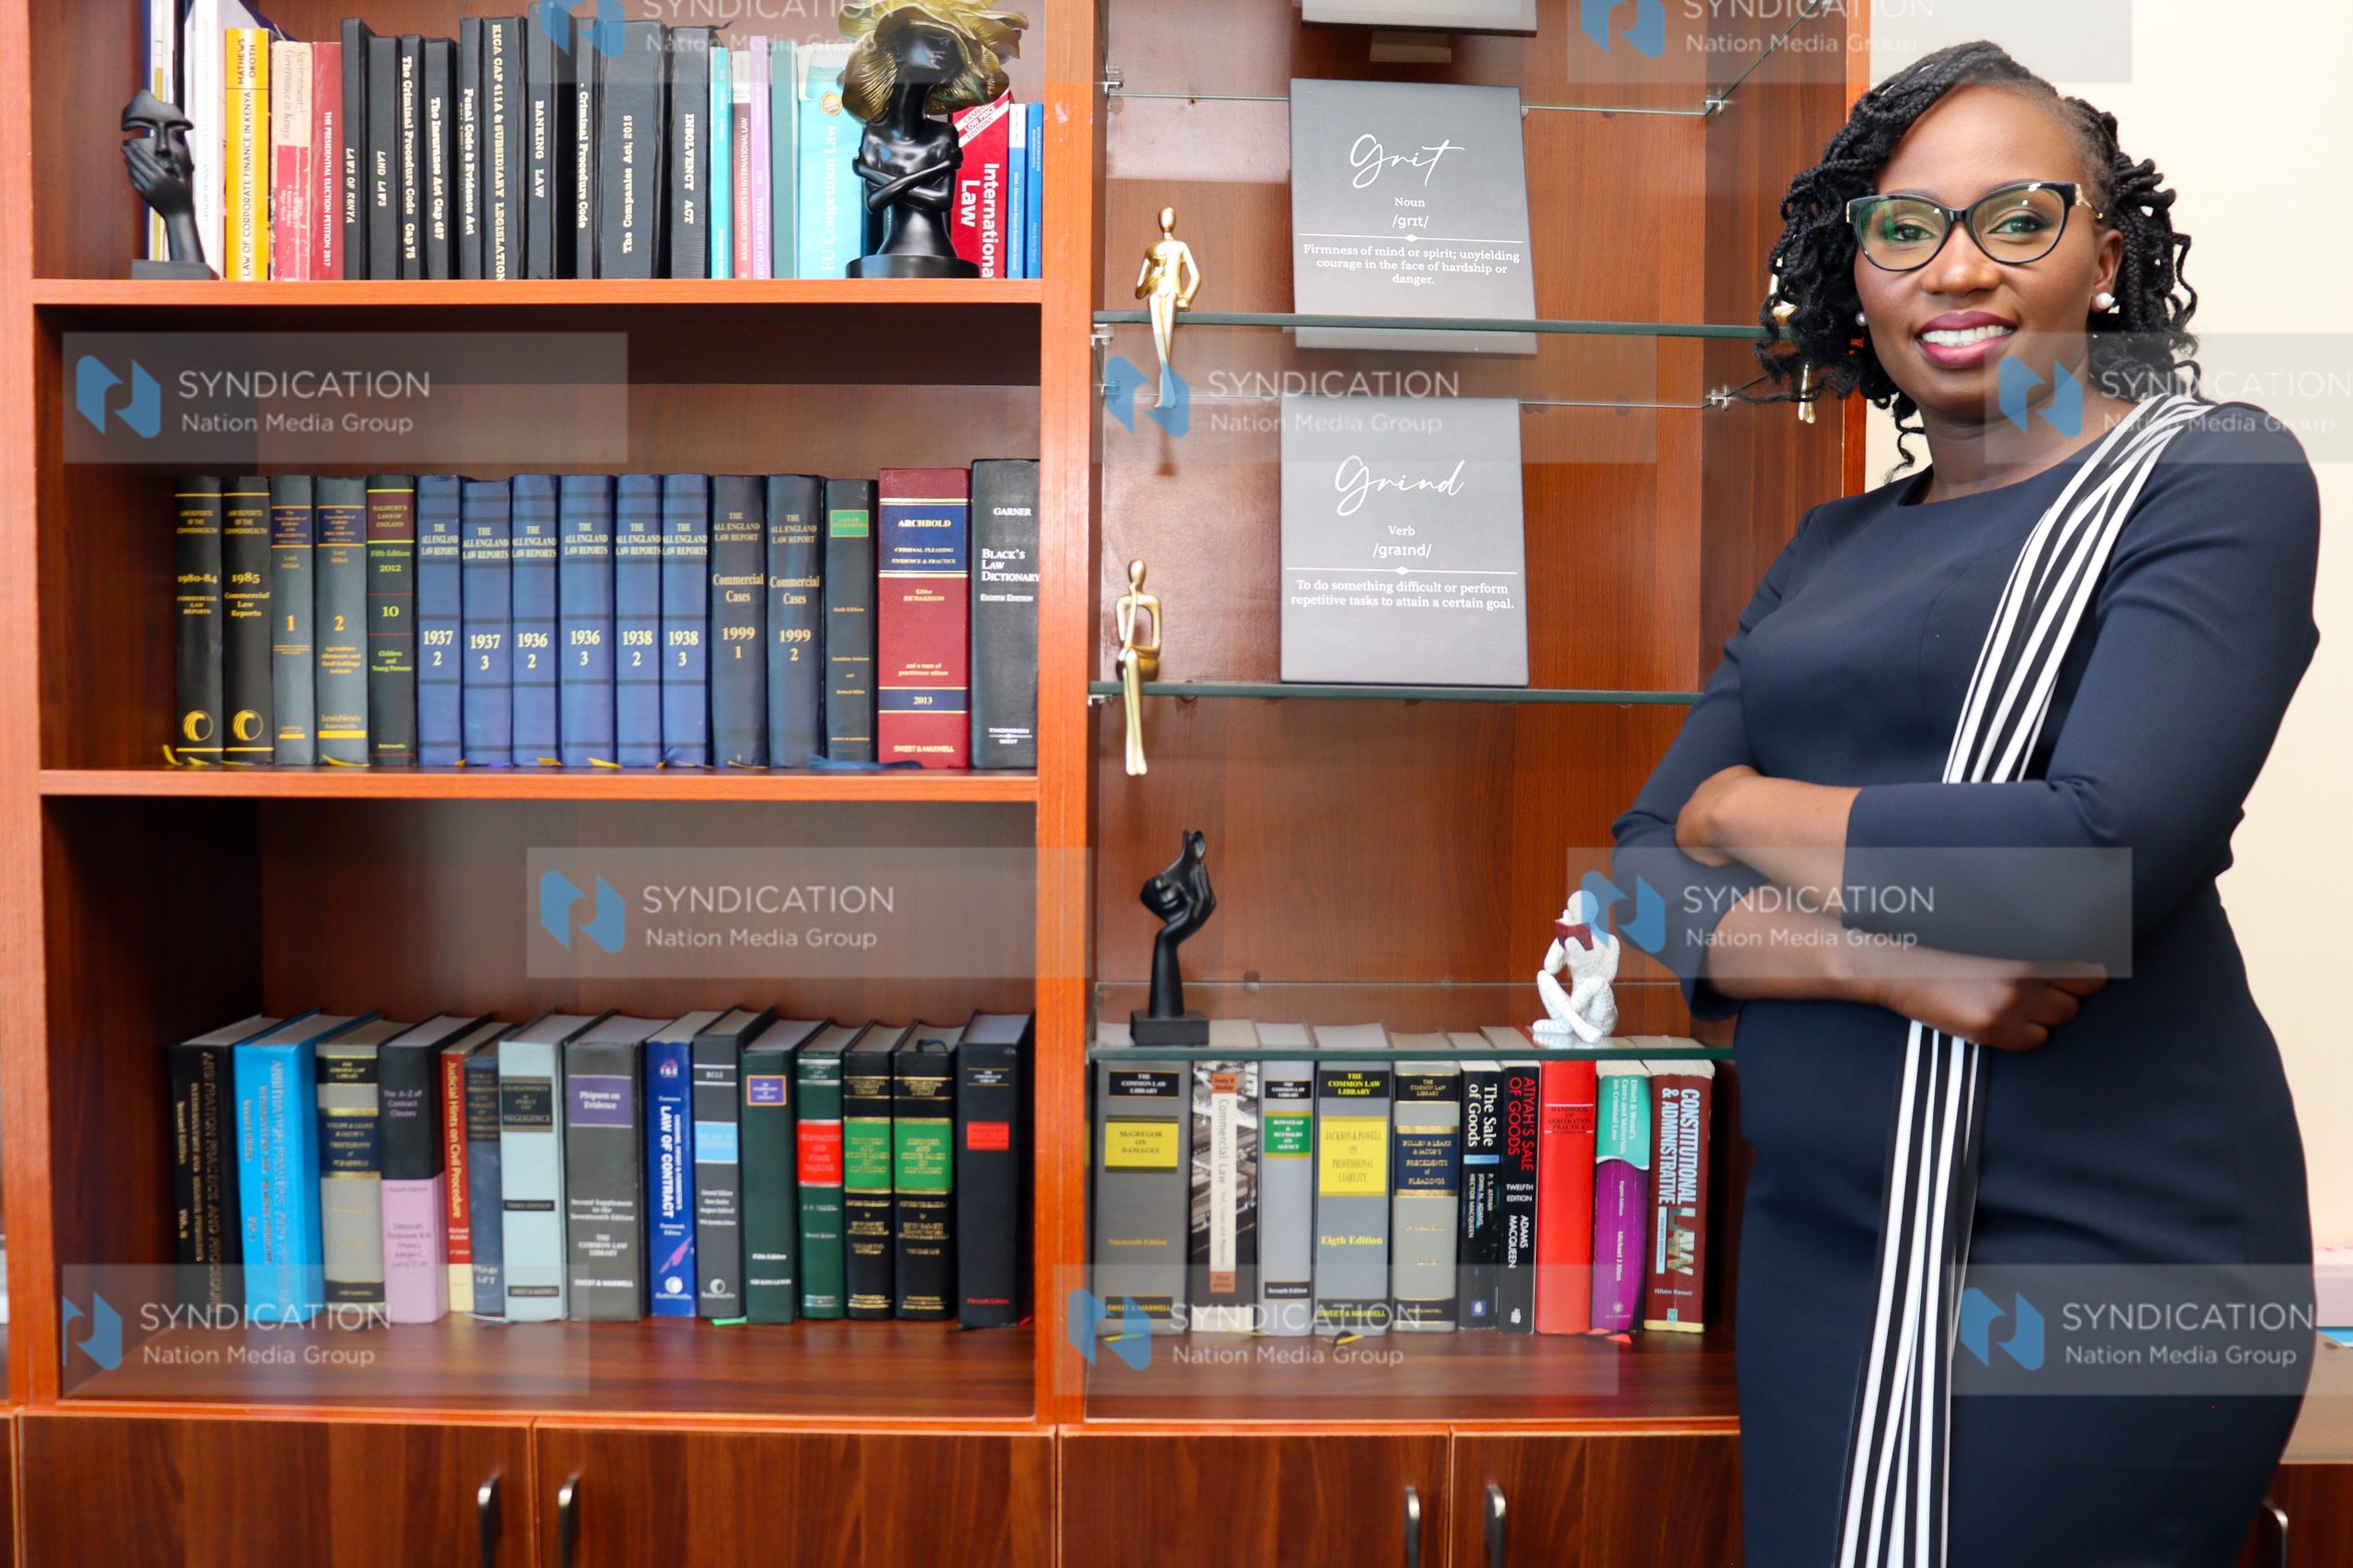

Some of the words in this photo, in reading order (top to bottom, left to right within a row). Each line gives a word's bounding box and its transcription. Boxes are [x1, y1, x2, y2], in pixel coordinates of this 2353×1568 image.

[237, 38, 245, 85] MATHEWS
[402, 56, 413, 78] The
[243, 92, 251, 122] KENYA
[403, 79, 414, 129] Criminal
[324, 110, 332, 125] THE
[623, 114, 632, 140] 2015
[243, 129, 251, 137] IN
[535, 100, 544, 160] BANKING
[324, 127, 332, 176] PRESIDENTIAL
[346, 147, 355, 175] LAWS
[403, 131, 415, 186] Procedure
[684, 113, 695, 191] INSOLVENCY
[1349, 133, 1465, 189] Grit
[243, 138, 251, 186] FINANCE
[377, 150, 386, 176] LAND
[346, 176, 355, 189] OF
[535, 168, 544, 199] LAW
[324, 178, 332, 213] ELECTION
[377, 180, 387, 207] LAWS
[404, 187, 415, 215] Code
[623, 167, 634, 228] Companies
[961, 179, 981, 227] Law
[1394, 197, 1426, 208] Noun
[243, 187, 251, 237] CORPORATE
[346, 191, 355, 224] KENYA
[684, 199, 695, 224] ACT
[982, 163, 1000, 278] Internationa
[324, 214, 332, 249] PETITION
[404, 222, 415, 244] Cap
[243, 239, 251, 253] OF
[404, 245, 416, 259] 75
[623, 232, 632, 254] The
[324, 250, 332, 267] 2017
[1303, 244, 1358, 256] Firmness
[1360, 245, 1374, 256] of
[1375, 245, 1405, 257] mind
[1423, 247, 1457, 262] spirit;
[1460, 249, 1520, 263] unyielding
[243, 256, 251, 277] LAW
[1316, 259, 1362, 272] courage
[1365, 258, 1377, 268] in
[1379, 259, 1398, 270] the
[1401, 260, 1425, 270] face
[1427, 261, 1440, 271] of
[1441, 261, 1493, 276] hardship
[1495, 265, 1507, 274] or
[1392, 274, 1435, 287] danger.
[1335, 455, 1465, 517] Grind
[994, 507, 1031, 517] GARNER
[897, 519, 951, 528] ARCHBOLD
[1388, 526, 1415, 537] Verb
[982, 560, 1005, 570] LAW
[232, 574, 261, 583] 1985
[712, 574, 764, 586] Commercial
[770, 575, 820, 588] Commercial
[1296, 579, 1311, 591] To
[1313, 580, 1329, 591] do
[1331, 581, 1393, 594] something
[1395, 581, 1442, 593] difficult
[1445, 585, 1458, 594] or
[1460, 583, 1508, 596] perform
[726, 590, 750, 603] Cases
[782, 593, 807, 605] Cases
[1290, 595, 1347, 608] repetitive
[1349, 596, 1379, 607] tasks
[1381, 597, 1393, 607] to
[1395, 597, 1430, 607] attain
[1442, 597, 1483, 608] certain
[1485, 597, 1515, 611] goal.
[382, 606, 399, 617] 10
[287, 616, 295, 631] 1
[334, 616, 346, 631] 2
[423, 631, 453, 645] 1937
[471, 634, 500, 649] 1937
[517, 632, 548, 647] 1936
[570, 631, 601, 644] 1936
[622, 631, 653, 645] 1938
[669, 631, 699, 645] 1938
[722, 628, 756, 641] 1999
[779, 630, 811, 642] 1999
[433, 652, 442, 665] 2
[528, 654, 537, 668] 2
[581, 652, 588, 665] 3
[632, 652, 642, 665] 2
[678, 652, 688, 665] 3
[735, 646, 743, 658] 1
[789, 649, 799, 662] 2
[481, 656, 489, 670] 3
[447, 1062, 460, 1099] Judicial
[1508, 1076, 1522, 1096] OF
[1468, 1083, 1481, 1099] of
[1483, 1083, 1498, 1113] The
[1662, 1087, 1678, 1097] &
[449, 1101, 460, 1127] Hints
[1521, 1076, 1536, 1136] ATIYAH'S
[660, 1106, 673, 1132] LAW
[1219, 1098, 1230, 1159] Commercial
[1467, 1101, 1481, 1147] Goods
[1507, 1100, 1521, 1156] GOODS
[449, 1129, 459, 1142] on
[1483, 1116, 1496, 1147] Sale
[661, 1134, 673, 1152] OF
[1658, 1100, 1677, 1205] ADMINISTRATIVE
[1677, 1088, 1700, 1205] CONSTITUTIONAL
[450, 1143, 461, 1165] Civil
[1521, 1140, 1535, 1171] SALE
[1219, 1164, 1229, 1184] Law
[450, 1167, 462, 1219] Procedure
[662, 1153, 675, 1219] CONTRACT
[1321, 1235, 1346, 1246] Eigth
[1349, 1235, 1382, 1245] Edition
[1507, 1215, 1518, 1268] MACQUEEN
[1520, 1215, 1529, 1248] ADAMS
[1667, 1207, 1697, 1276] LAW
